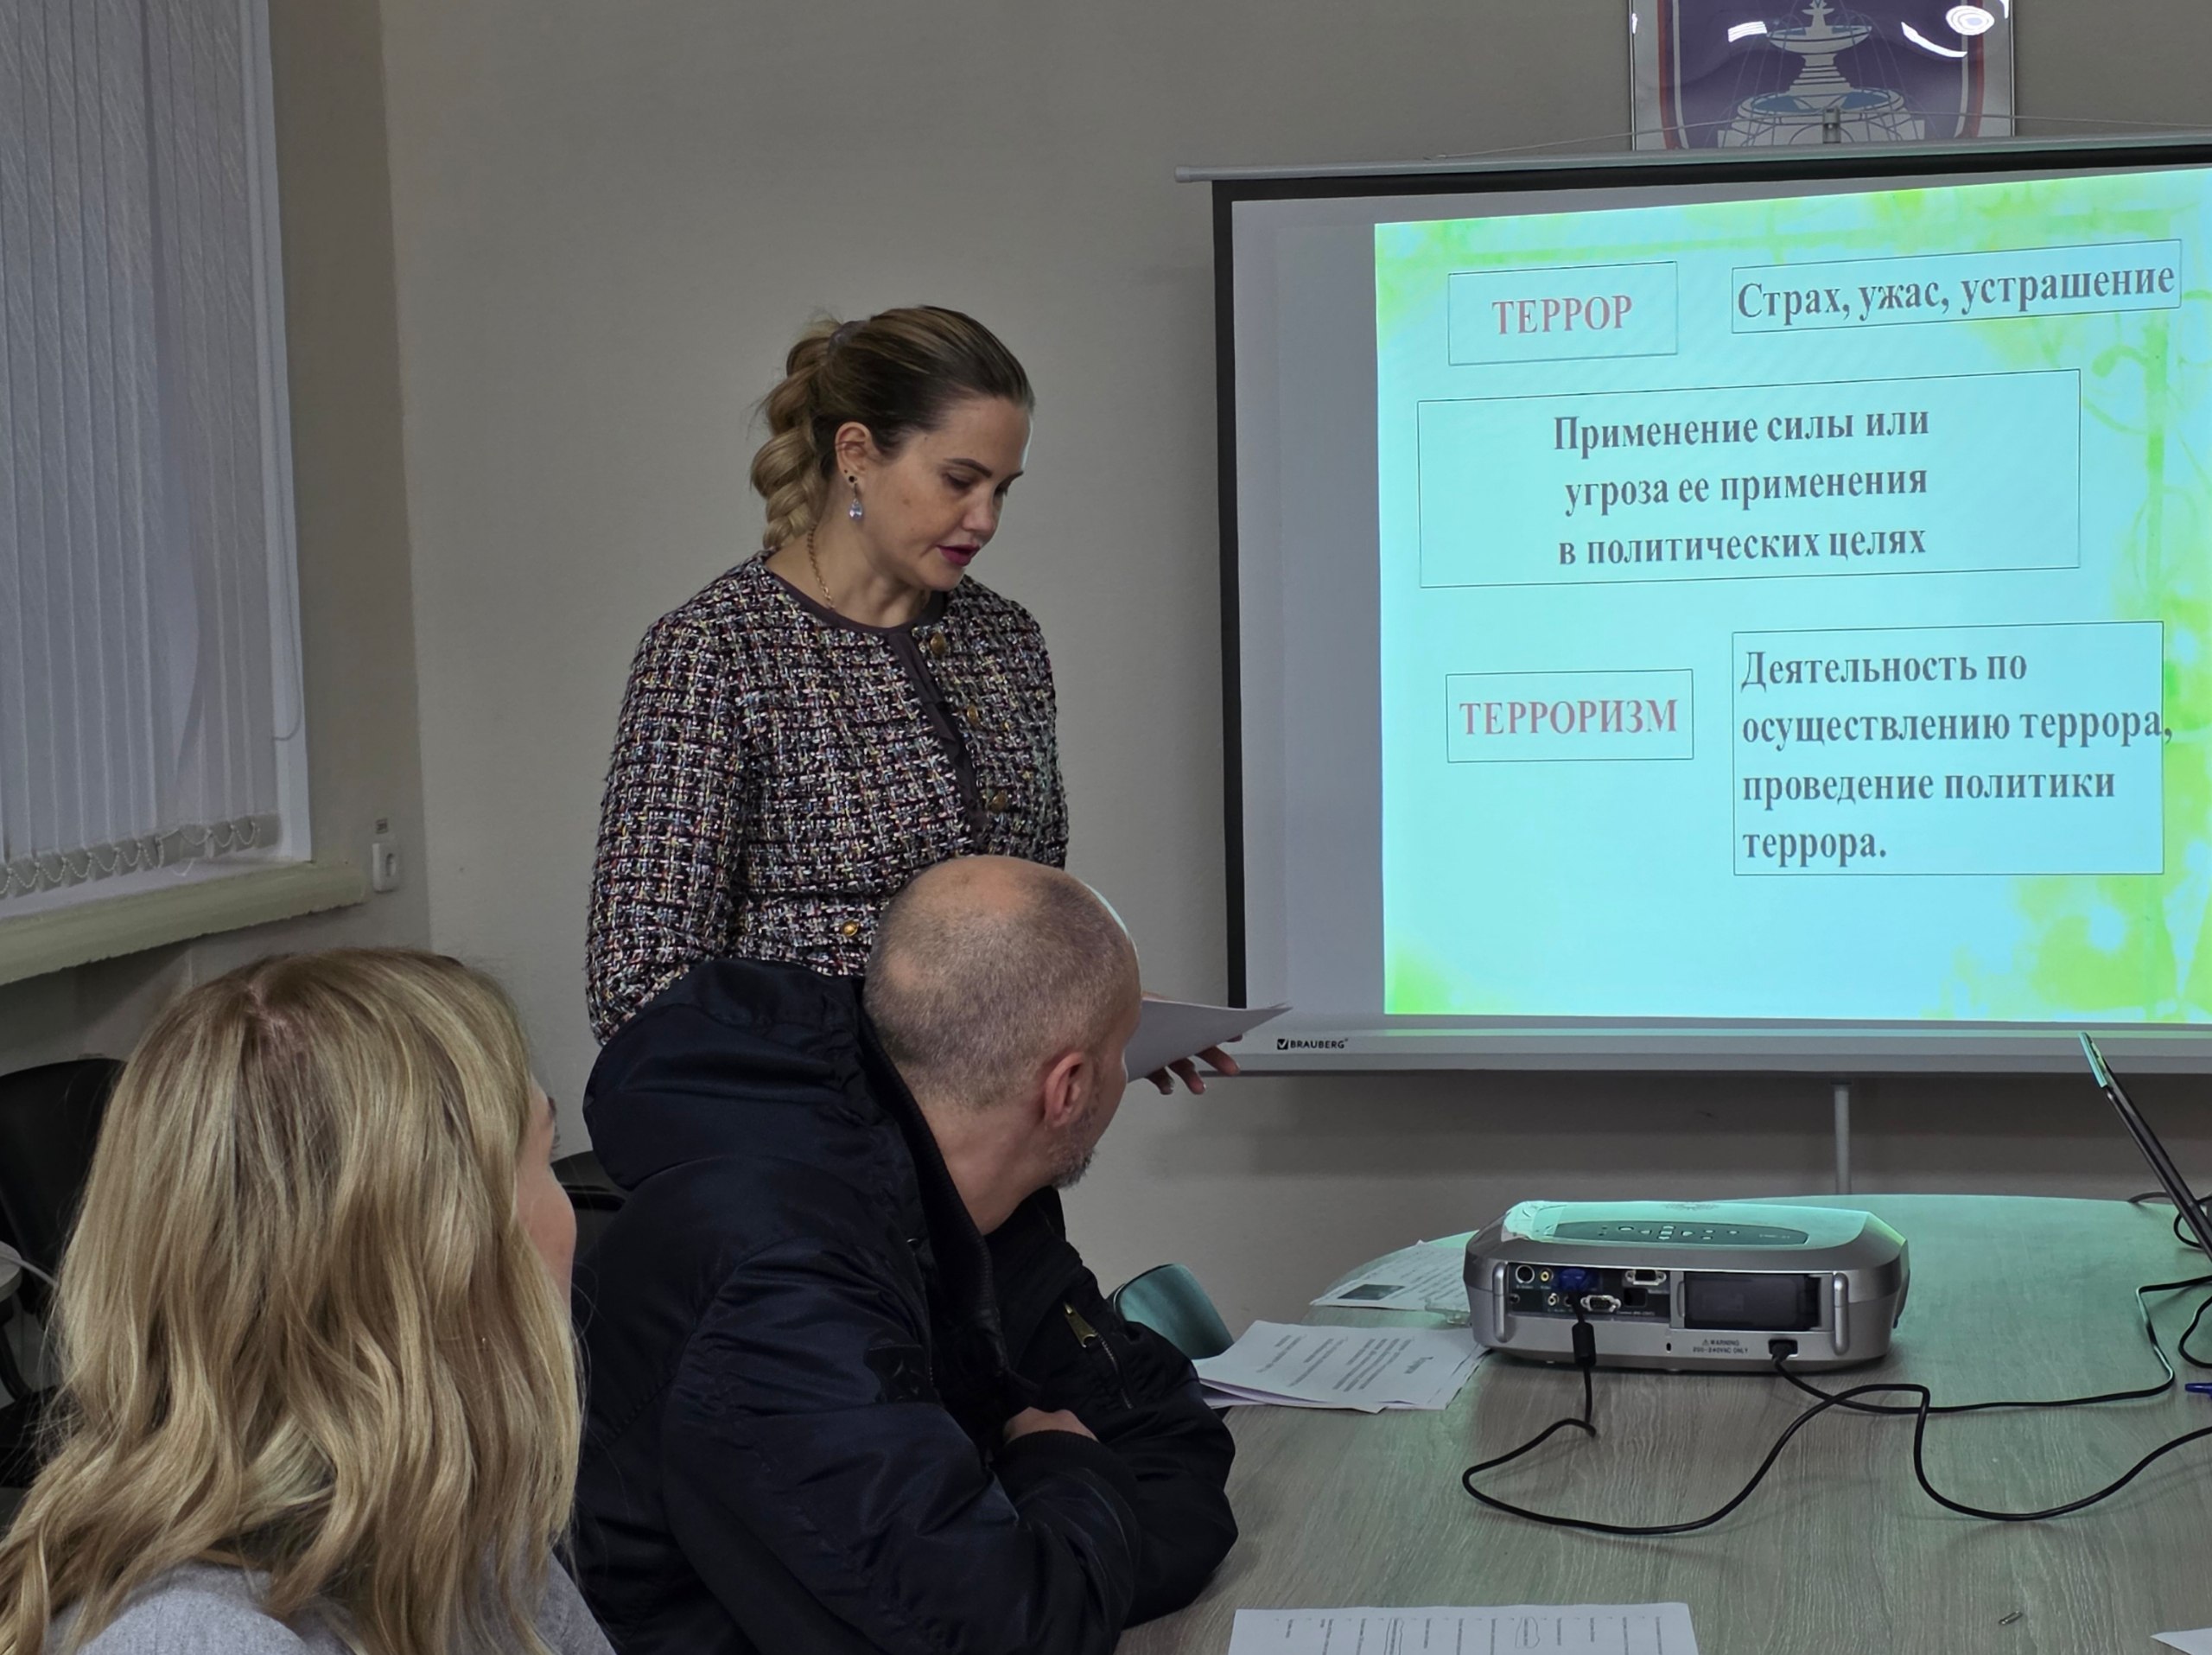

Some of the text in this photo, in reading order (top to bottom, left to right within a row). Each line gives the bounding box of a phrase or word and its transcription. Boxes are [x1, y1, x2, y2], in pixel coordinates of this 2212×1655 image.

[1491, 295, 1632, 335] ТЕРРОР
[1738, 267, 2176, 324] Страх, ужас, устрашение
[1554, 411, 1930, 461] Применение силы или
[1564, 469, 1929, 518] угроза ее применения
[1559, 530, 1927, 565] в политических целях
[1740, 650, 2028, 693] Деятельность по
[1459, 699, 1678, 735] ТЕРРОРИЗМ
[1742, 710, 2174, 753] осуществлению террора,
[1742, 773, 2116, 808] проведение политики
[1742, 833, 1888, 869] террора.
